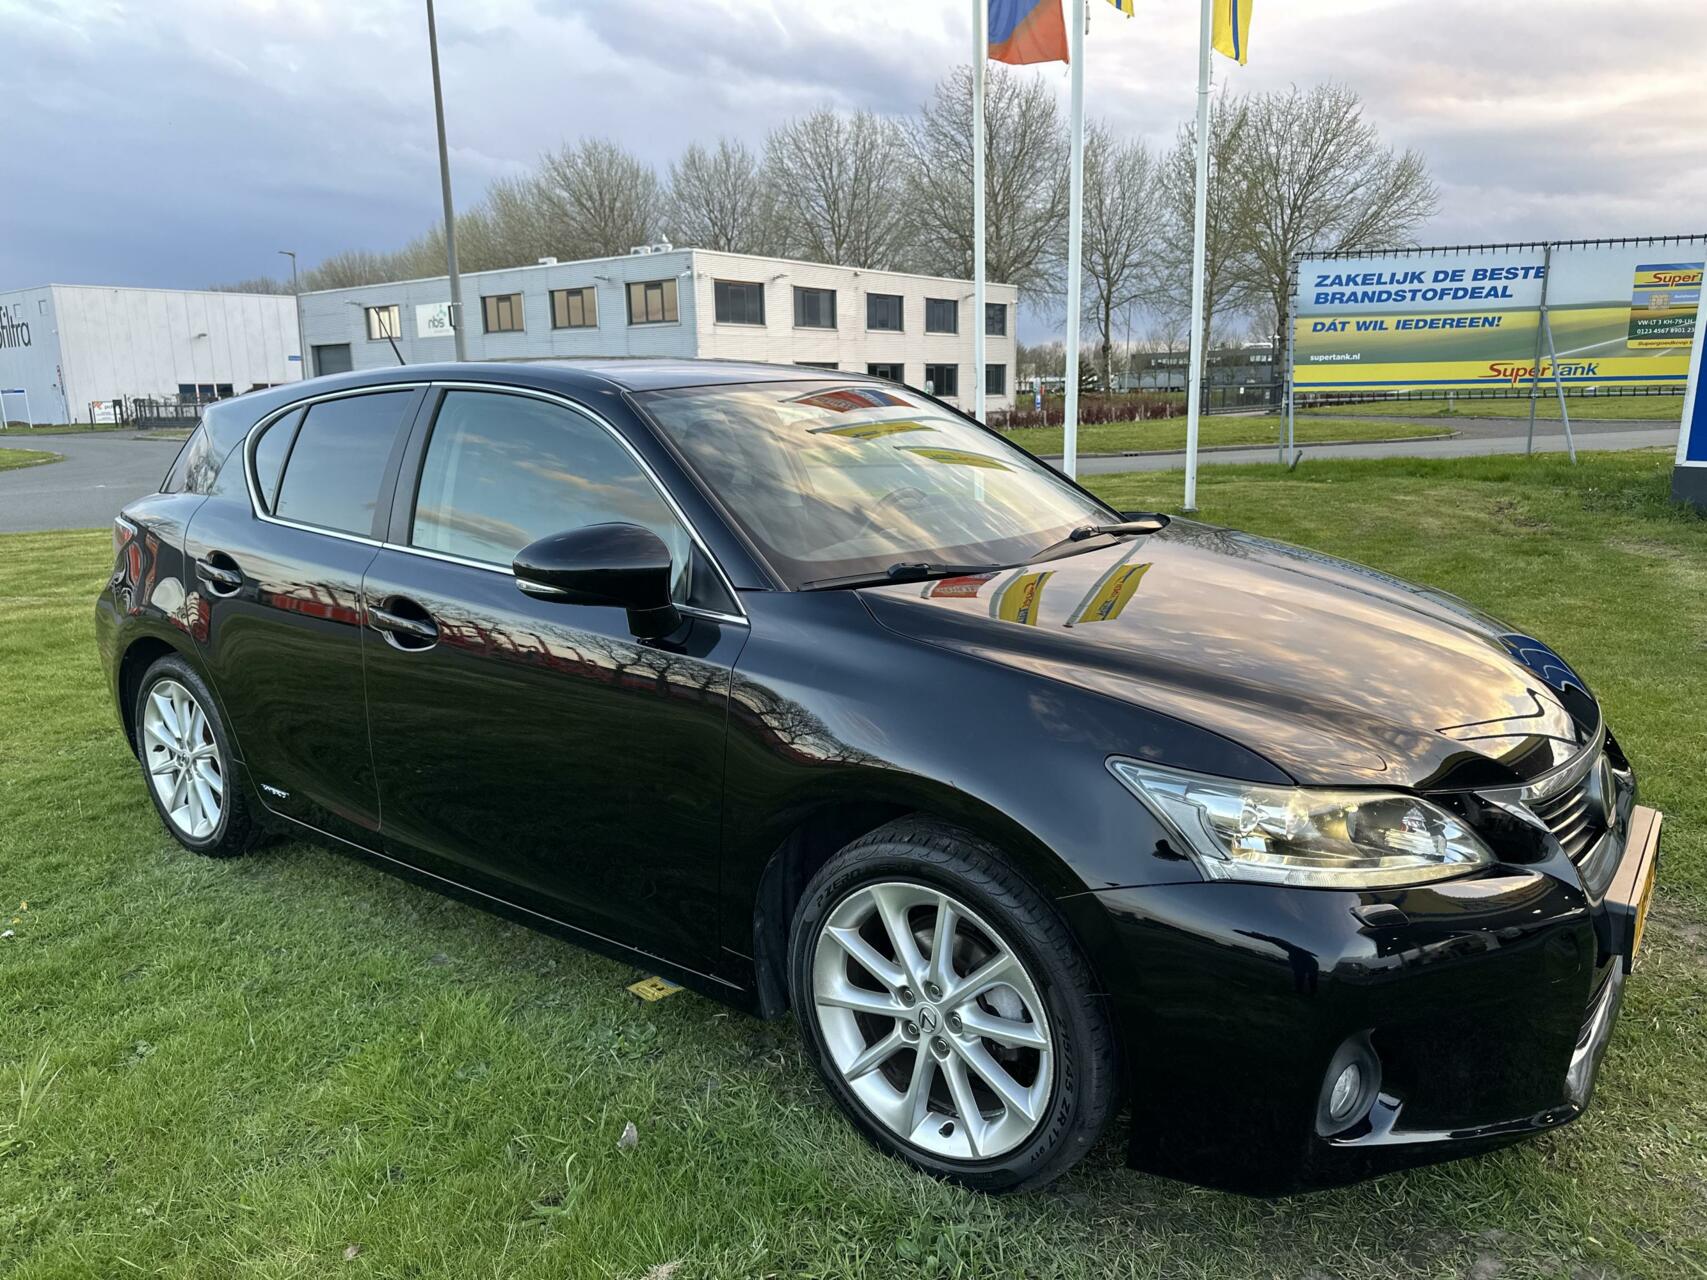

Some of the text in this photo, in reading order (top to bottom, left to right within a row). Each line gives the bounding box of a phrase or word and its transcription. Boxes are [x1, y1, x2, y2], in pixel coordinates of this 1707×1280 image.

[1314, 266, 1549, 287] ZAKELIJK DE BESTE
[1314, 285, 1513, 304] BRANDSTOFDEAL
[0, 305, 31, 349] filtra
[1312, 316, 1502, 333] DÁT WIL IEDEREEN!
[1310, 353, 1360, 361] supertank.nl
